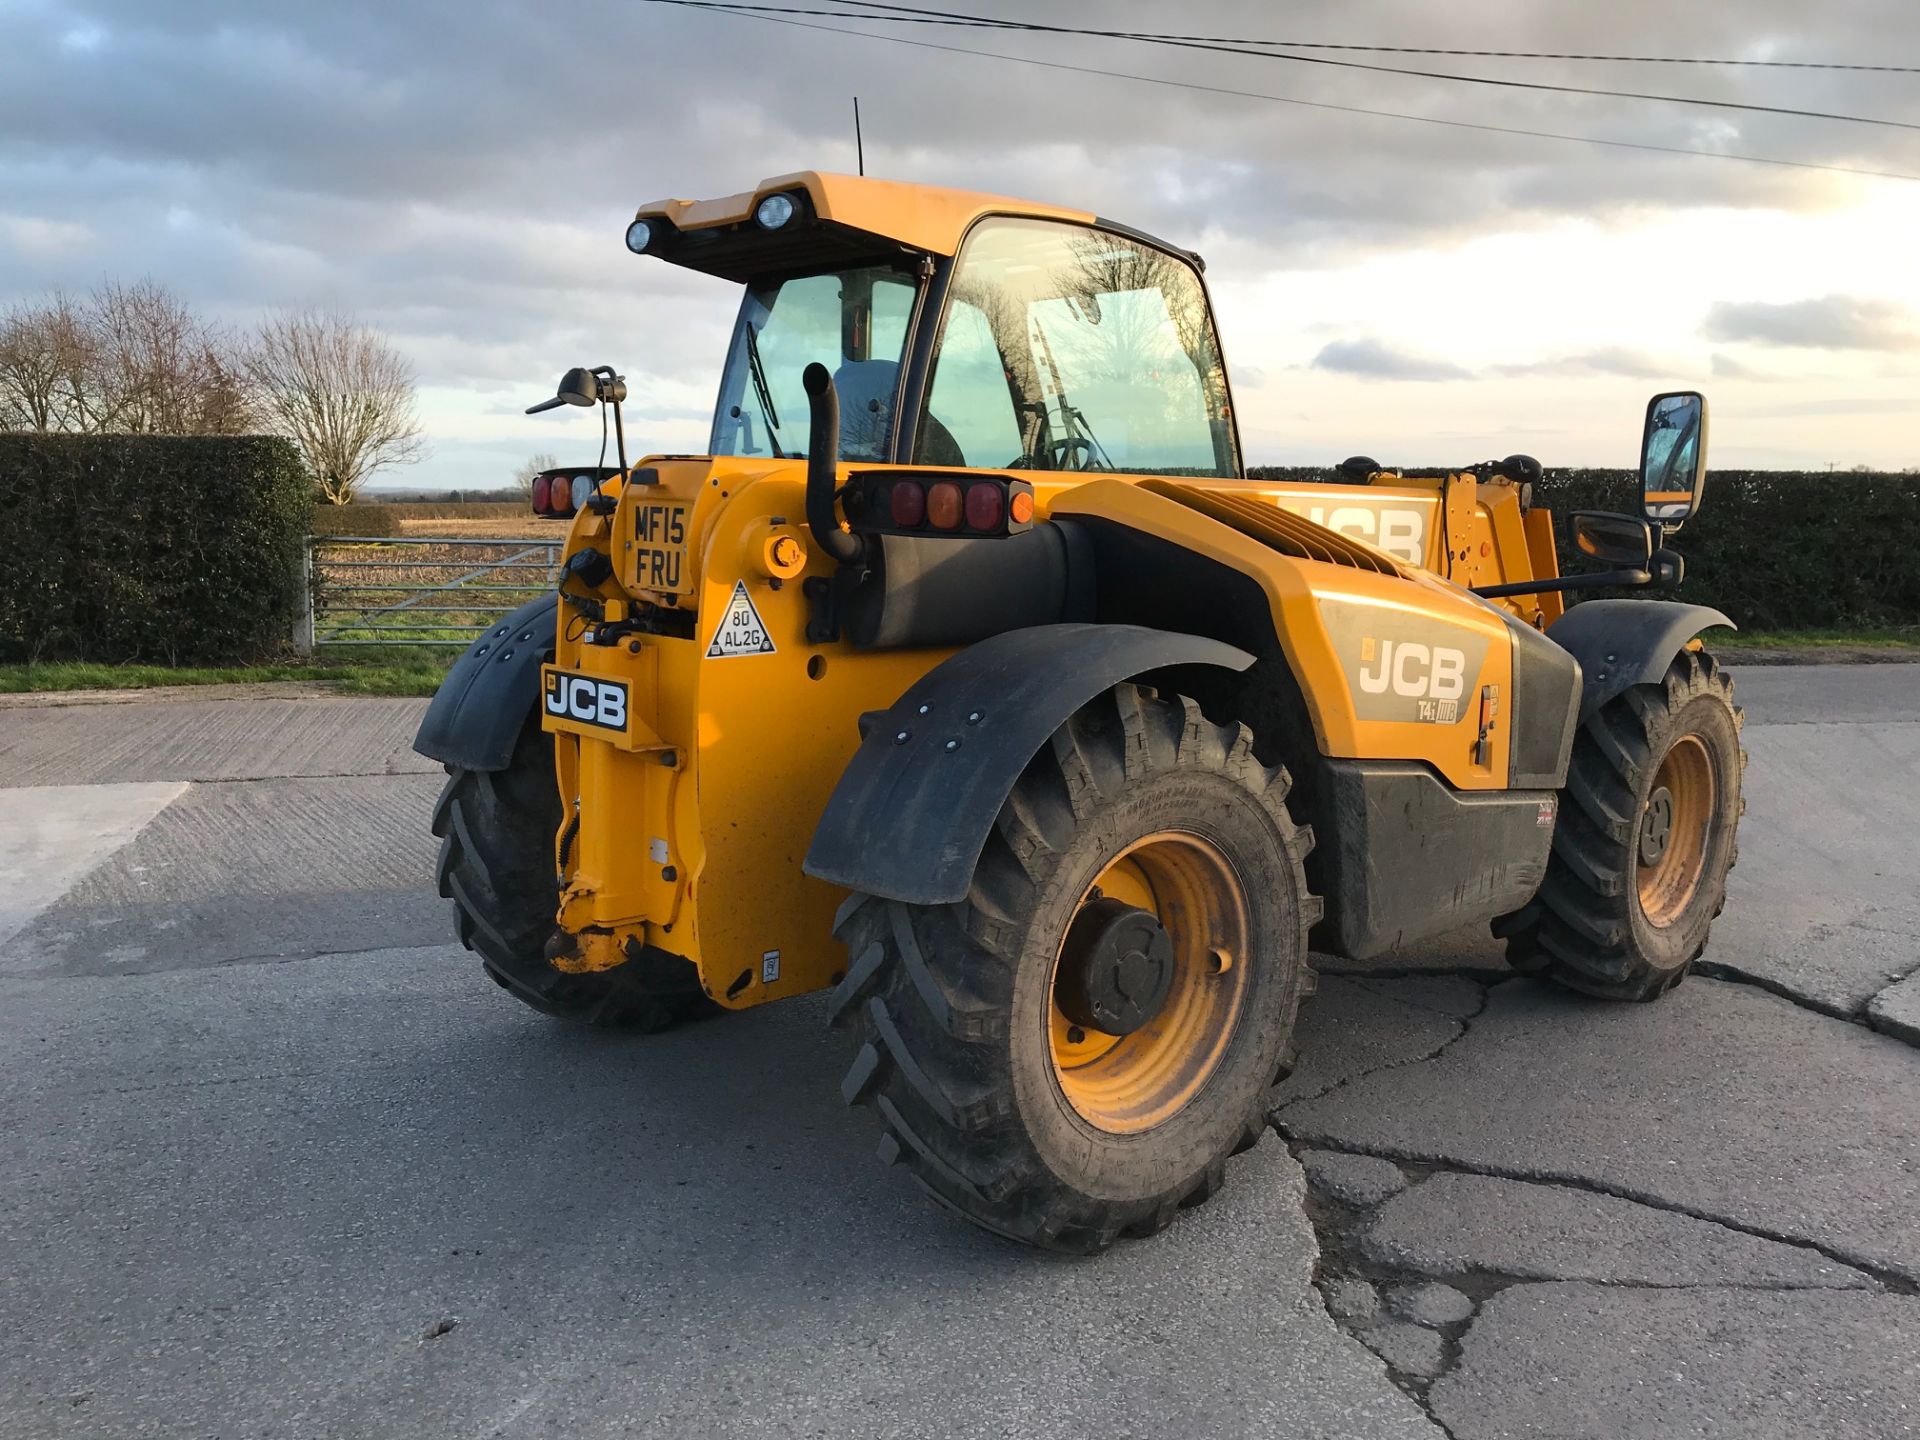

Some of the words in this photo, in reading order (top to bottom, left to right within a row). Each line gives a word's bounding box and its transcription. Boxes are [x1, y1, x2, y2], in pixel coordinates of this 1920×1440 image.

[635, 506, 684, 544] MF15
[1310, 507, 1423, 568] CB
[637, 549, 680, 587] FRU
[733, 611, 750, 626] 80
[725, 630, 760, 647] AL2G
[1359, 640, 1465, 699] JCB
[547, 676, 625, 727] JCB
[1418, 701, 1436, 721] T4i
